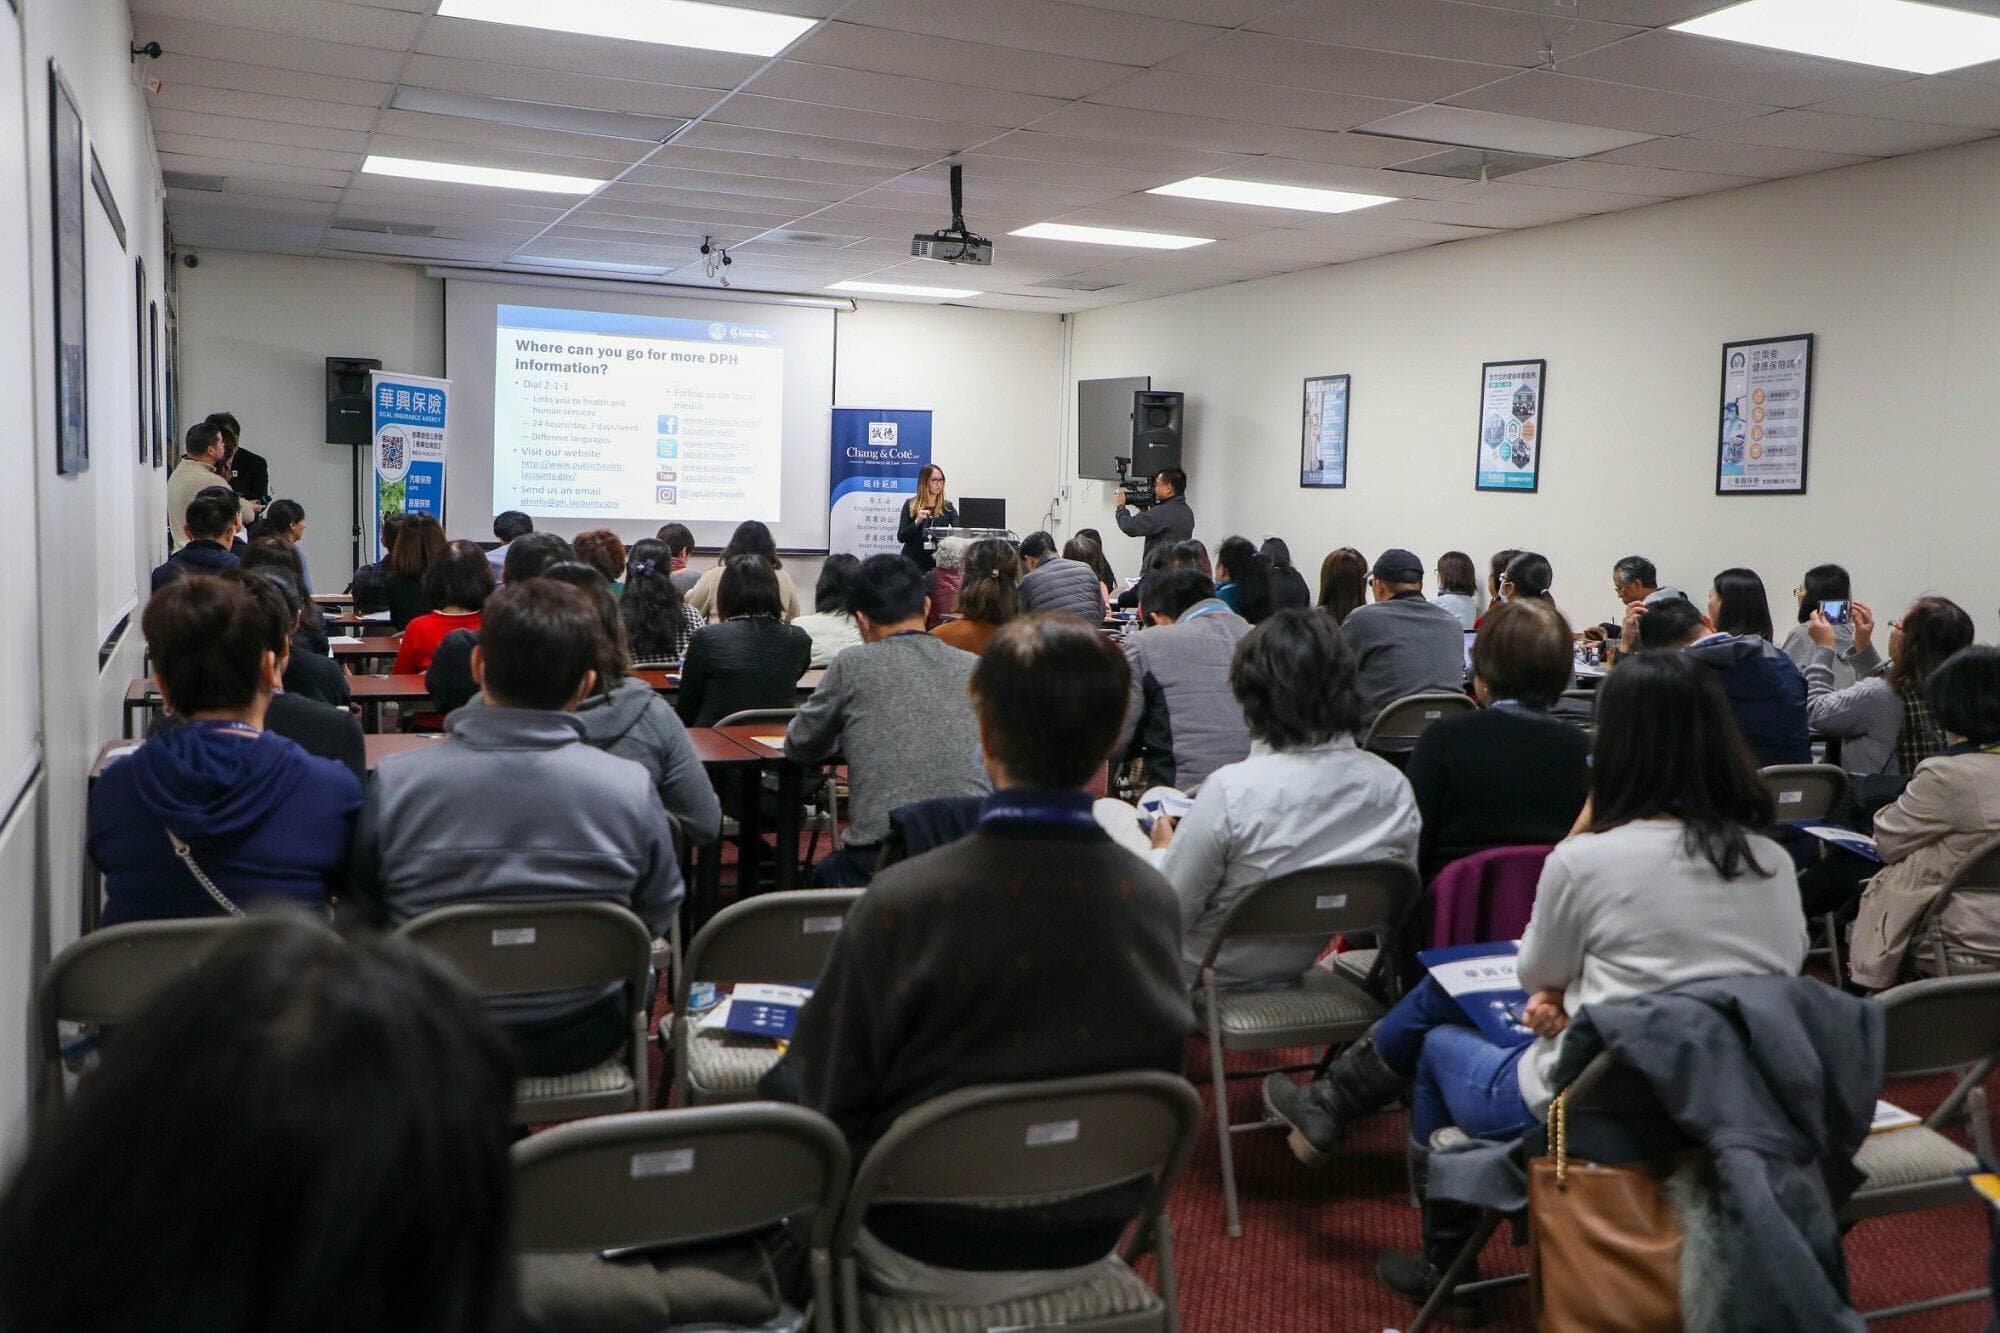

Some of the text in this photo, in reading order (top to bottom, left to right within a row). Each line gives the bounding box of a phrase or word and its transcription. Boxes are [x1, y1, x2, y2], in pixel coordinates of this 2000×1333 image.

[515, 339, 738, 364] Where can you go for more DPH
[515, 358, 608, 374] information?
[523, 380, 568, 390] Dial 2-1-1
[674, 388, 702, 398] Follow
[380, 388, 442, 414] 華興保險
[583, 398, 608, 406] health
[532, 407, 561, 415] human
[597, 422, 640, 431] days/week
[532, 433, 610, 444] Different languages
[521, 447, 542, 456] Visit
[564, 449, 600, 458] website
[846, 447, 879, 460] Chang
[880, 450, 888, 458] &
[889, 448, 913, 459] Coté
[521, 471, 576, 481] lacounty.gov/
[521, 485, 544, 494] Send
[575, 487, 601, 495] email
[681, 489, 745, 498] @lapublichealth
[521, 498, 620, 508] phinfo@ph.lacounty.gov
